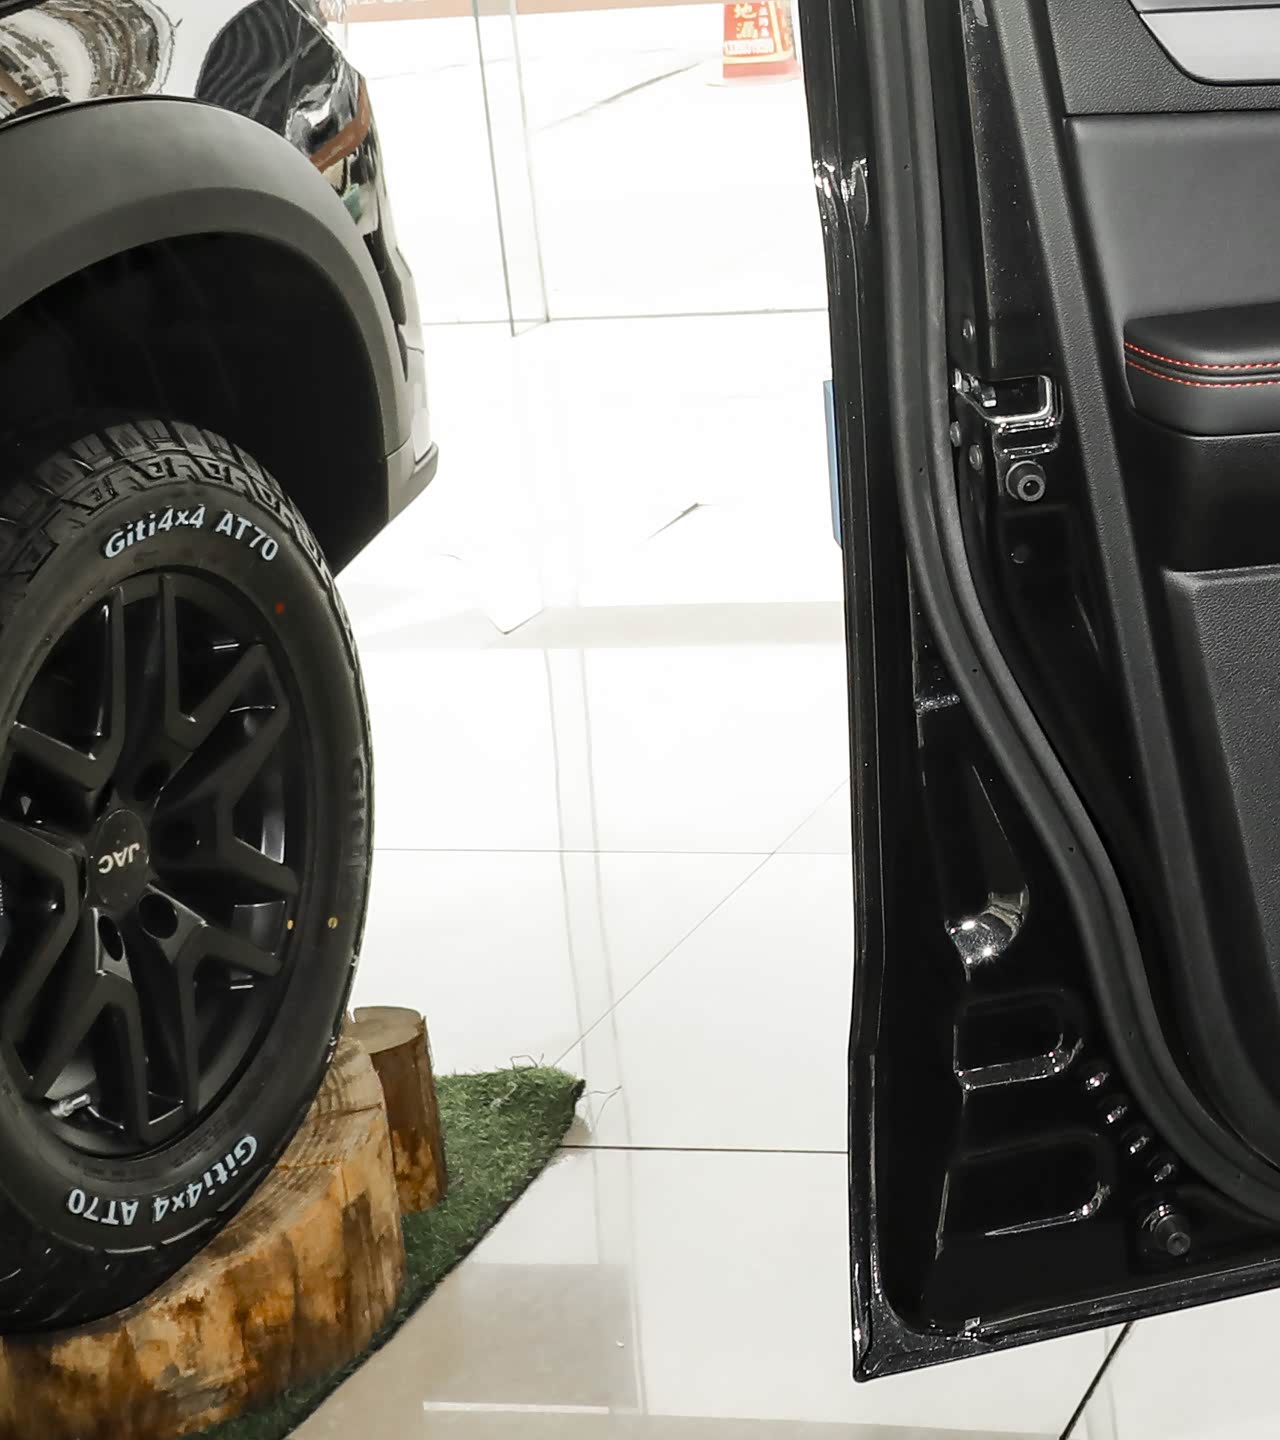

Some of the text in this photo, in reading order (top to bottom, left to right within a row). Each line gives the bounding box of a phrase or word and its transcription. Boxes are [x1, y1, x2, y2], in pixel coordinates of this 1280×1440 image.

[105, 504, 279, 561] Giti4x4 AT70
[98, 843, 140, 874] JAC
[68, 1188, 139, 1226] AT70
